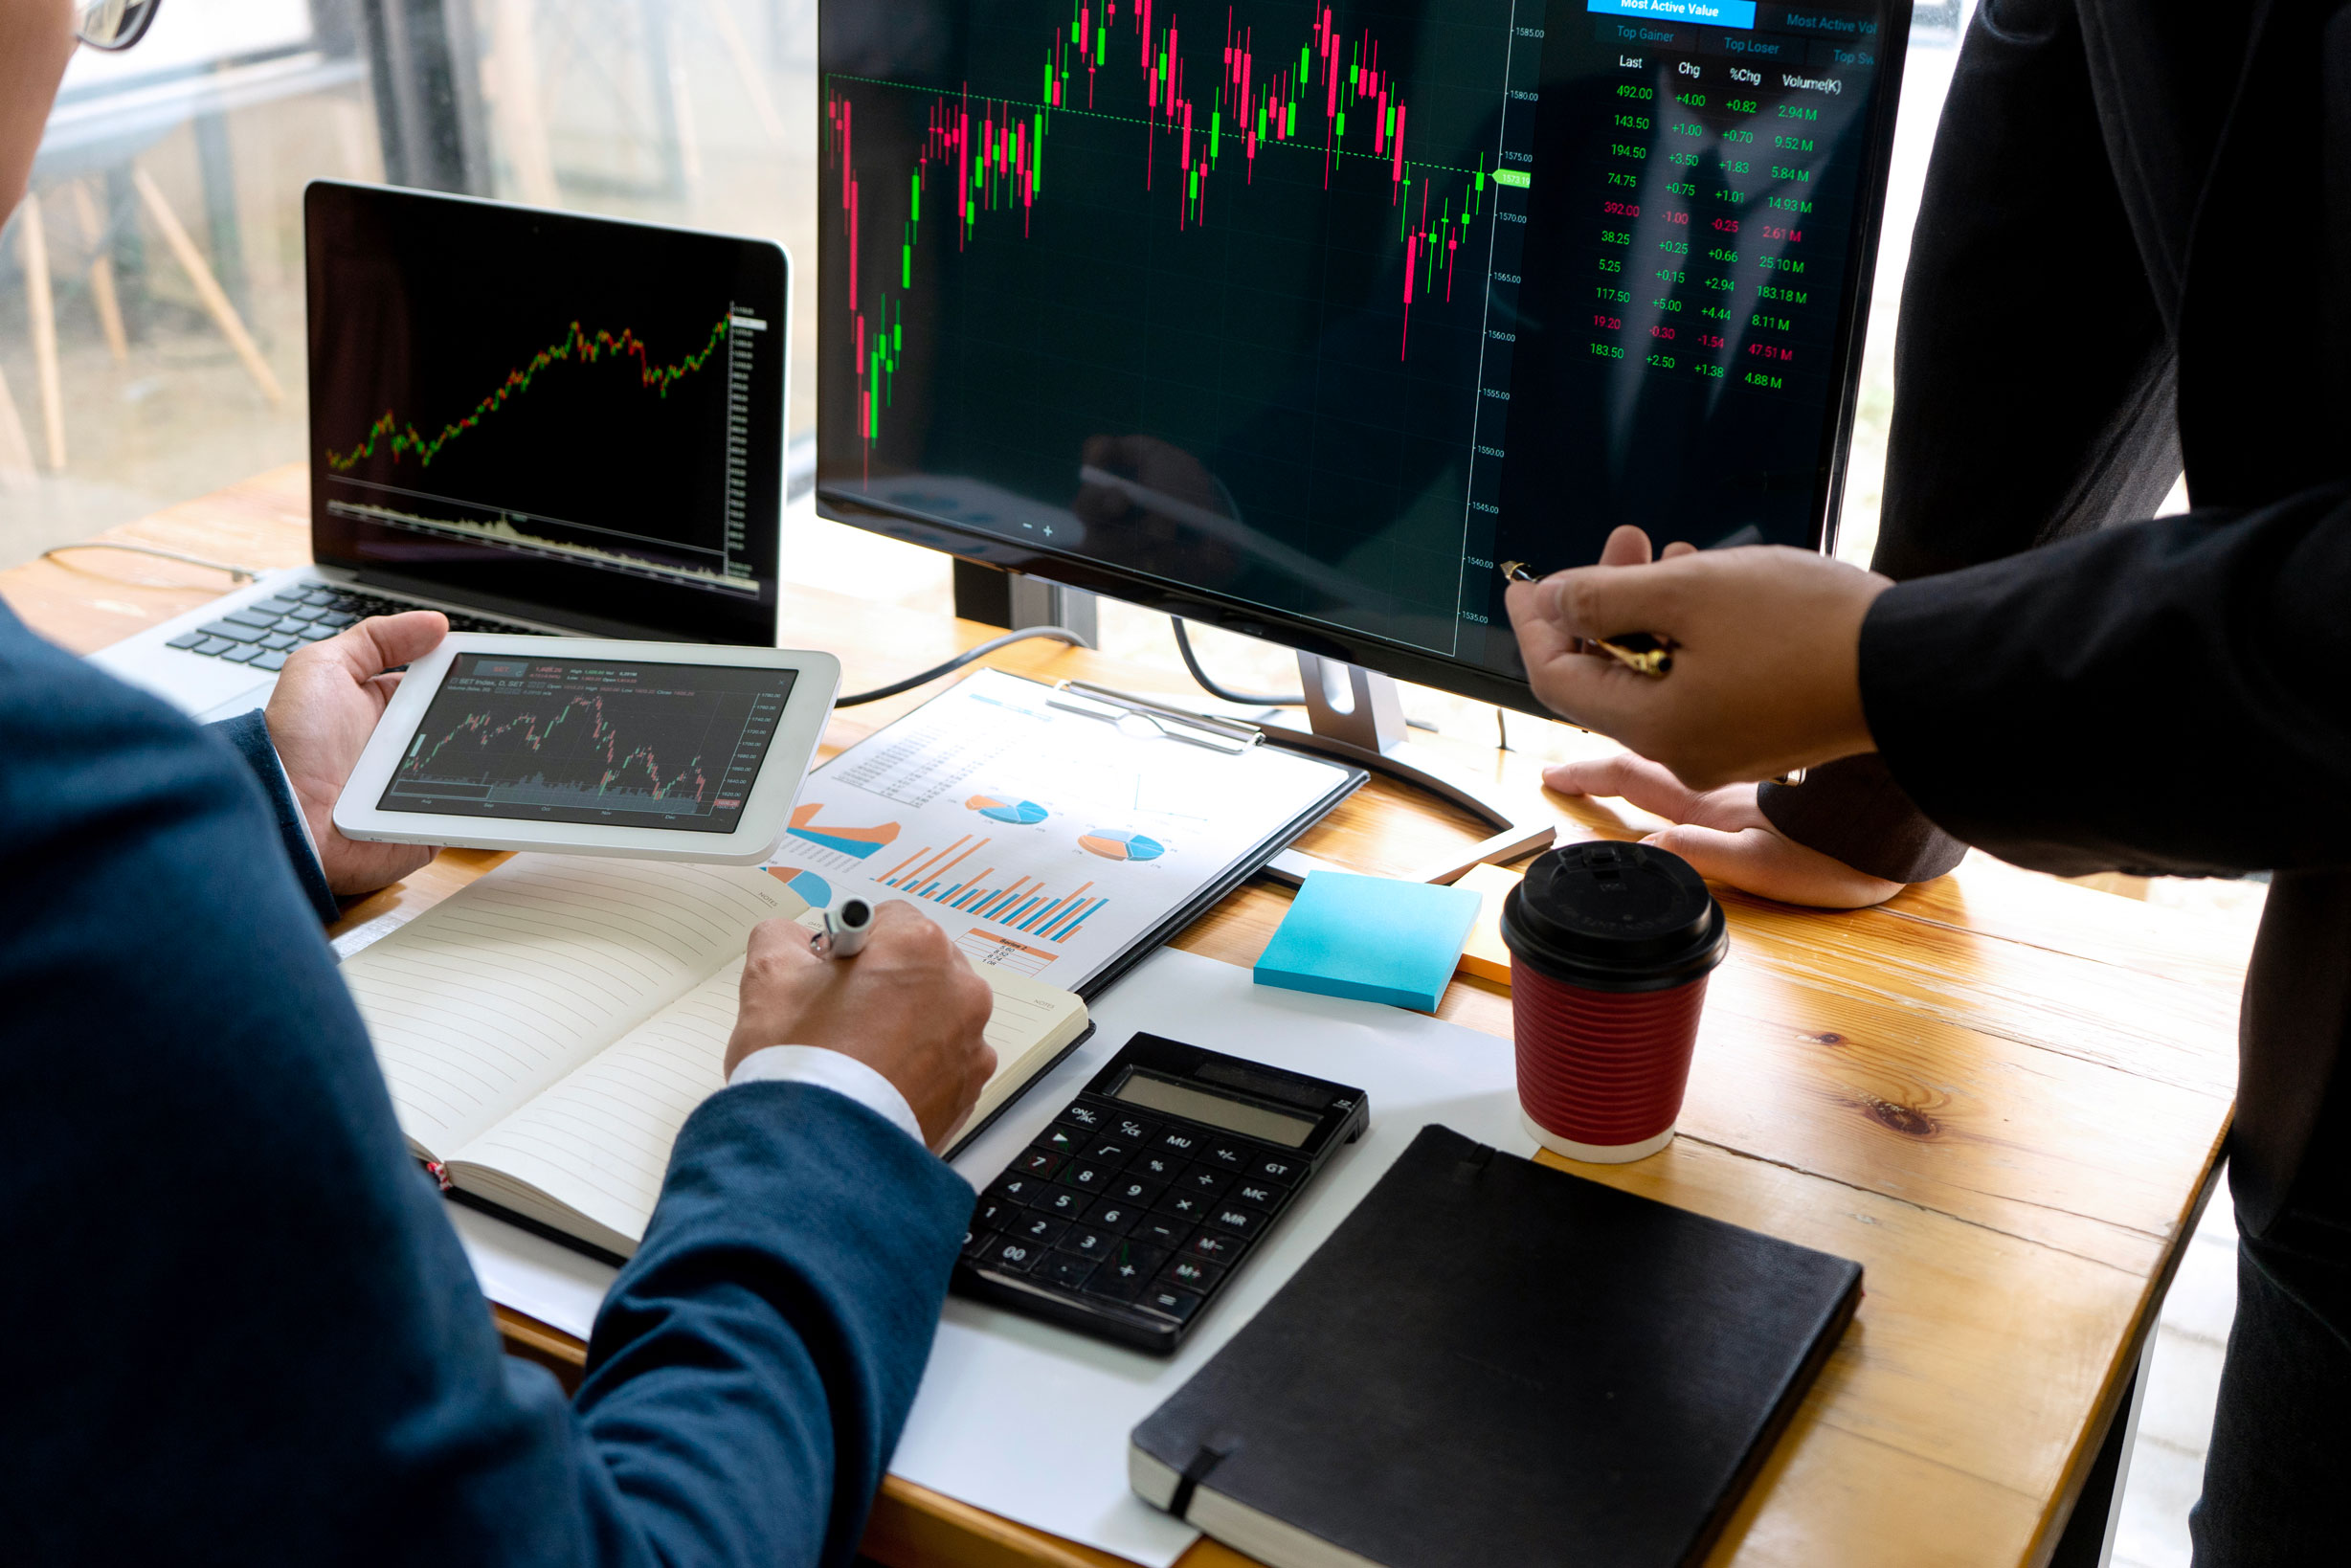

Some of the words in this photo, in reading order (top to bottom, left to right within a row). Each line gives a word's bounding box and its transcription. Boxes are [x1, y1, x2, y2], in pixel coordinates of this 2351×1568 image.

[1621, 0, 1647, 10] Most
[1650, 0, 1685, 13] Active
[1688, 3, 1719, 17] Value
[1786, 13, 1817, 28] Most
[1819, 17, 1856, 32] Active
[1516, 27, 1544, 38] 1585.00
[1617, 25, 1637, 40] Top
[1639, 28, 1674, 42] Gainer
[1724, 36, 1745, 52] Top
[1747, 40, 1780, 55] Loser
[1833, 49, 1855, 66] Top
[1620, 55, 1643, 70] Last
[1678, 62, 1701, 78] Chg
[1730, 68, 1761, 86] %Chg
[1782, 75, 1843, 95] Volume(K)
[1511, 90, 1538, 101] 1580.00
[1617, 85, 1653, 100] 492.00
[1676, 94, 1706, 107] +4.00
[1726, 100, 1757, 114] +0.82
[1779, 105, 1802, 119] 2.94
[1805, 109, 1818, 121] M
[1614, 115, 1649, 129] 143.50
[1672, 123, 1702, 136] +1.00
[1723, 130, 1753, 143] +0.70
[1775, 136, 1799, 149] 9.52
[1801, 140, 1813, 151] M
[1505, 150, 1533, 162] 1575.00
[1611, 145, 1646, 159] 194.50
[1668, 153, 1698, 167] +3.50
[1719, 161, 1749, 174] +1.83
[1771, 166, 1795, 179] 5.84
[1797, 170, 1809, 182] M
[1608, 172, 1637, 188] 74.75
[1666, 182, 1695, 195] +0.75
[1715, 190, 1745, 204] +1.01
[1768, 197, 1798, 211] 14.93
[1800, 200, 1812, 213] M
[1499, 212, 1527, 224] 1570.00
[1604, 201, 1640, 217] 392.00
[1662, 212, 1689, 224] -1.00
[1712, 218, 1739, 233] -0.25
[1763, 226, 1787, 240] 2.61
[1789, 230, 1802, 242] M
[1601, 231, 1630, 245] 38.25
[1659, 241, 1689, 255] +0.25
[1709, 249, 1738, 261] +0.66
[1759, 257, 1790, 271] 25.10
[1792, 260, 1804, 273] M
[1493, 273, 1521, 284] 1565.00
[1599, 259, 1621, 273] 5.25
[1655, 269, 1686, 283] +0.15
[1705, 278, 1735, 291] +2.94
[1758, 286, 1793, 302] 183.18
[1795, 291, 1807, 303] M
[1596, 287, 1630, 302] 117.50
[1653, 299, 1682, 312] +5.00
[1701, 307, 1731, 321] +4.44
[1752, 315, 1776, 327] 8.11
[1778, 319, 1790, 331] M
[1488, 332, 1515, 343] 1560.00
[1594, 315, 1621, 329] 19.20
[1649, 326, 1675, 339] -0.30
[1698, 335, 1724, 348] -1.54
[1749, 344, 1778, 358] 47.51
[1780, 348, 1793, 360] M
[1591, 344, 1624, 359] 183.50
[1646, 355, 1675, 369] +2.50
[1694, 364, 1724, 378] +1.38
[1745, 372, 1768, 387] 4.88
[1769, 377, 1782, 390] M
[1483, 388, 1510, 400] 1555.00
[1477, 444, 1504, 458] 1550.00
[1472, 501, 1499, 514] 1545.00
[1467, 556, 1493, 570] 1540.00
[1462, 611, 1489, 624] 1535.00
[758, 891, 778, 907] NOTES
[1034, 998, 1055, 1009] NOTES
[1166, 1135, 1192, 1149] MU
[1031, 1156, 1046, 1167] 7
[1079, 1170, 1094, 1182] 8
[1265, 1163, 1288, 1175] GT
[1008, 1182, 1022, 1193] 4
[1127, 1184, 1142, 1197] 9
[1242, 1187, 1268, 1201] MC
[1055, 1195, 1071, 1207] 5
[985, 1206, 996, 1218] 1
[1104, 1210, 1121, 1222] 6
[1220, 1211, 1247, 1226] MR
[1030, 1221, 1046, 1234] 2
[1080, 1235, 1097, 1248] 3
[1002, 1245, 1026, 1261] 00
